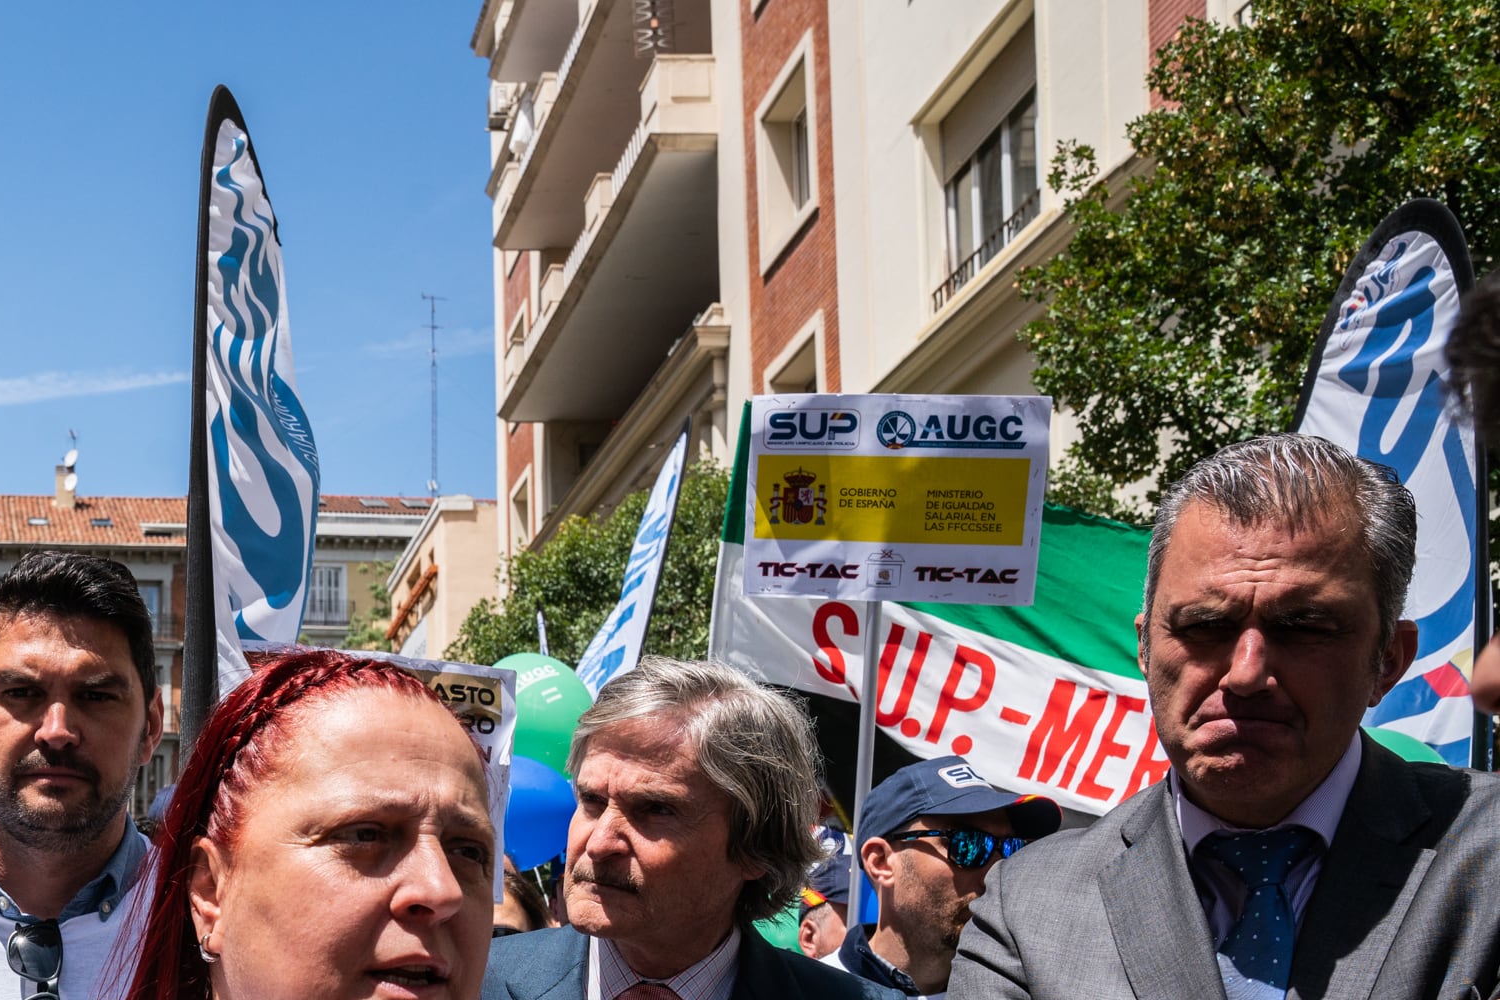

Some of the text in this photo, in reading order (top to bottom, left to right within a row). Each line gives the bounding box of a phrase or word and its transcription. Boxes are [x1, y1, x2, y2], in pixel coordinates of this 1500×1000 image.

[769, 412, 857, 440] SUP
[920, 414, 1024, 441] AUGC
[839, 488, 897, 498] GOBIERNO
[927, 489, 984, 499] MINISTERIO
[839, 497, 896, 509] DE ESPAÑA
[925, 501, 995, 511] DE IGUALDAD
[924, 511, 996, 521] SALARIAL EN
[924, 522, 1003, 533] LAS FFCCSSEE
[758, 561, 860, 580] TIC-TAC
[913, 566, 1019, 585] TIC-TAC
[434, 682, 495, 706] ASTO
